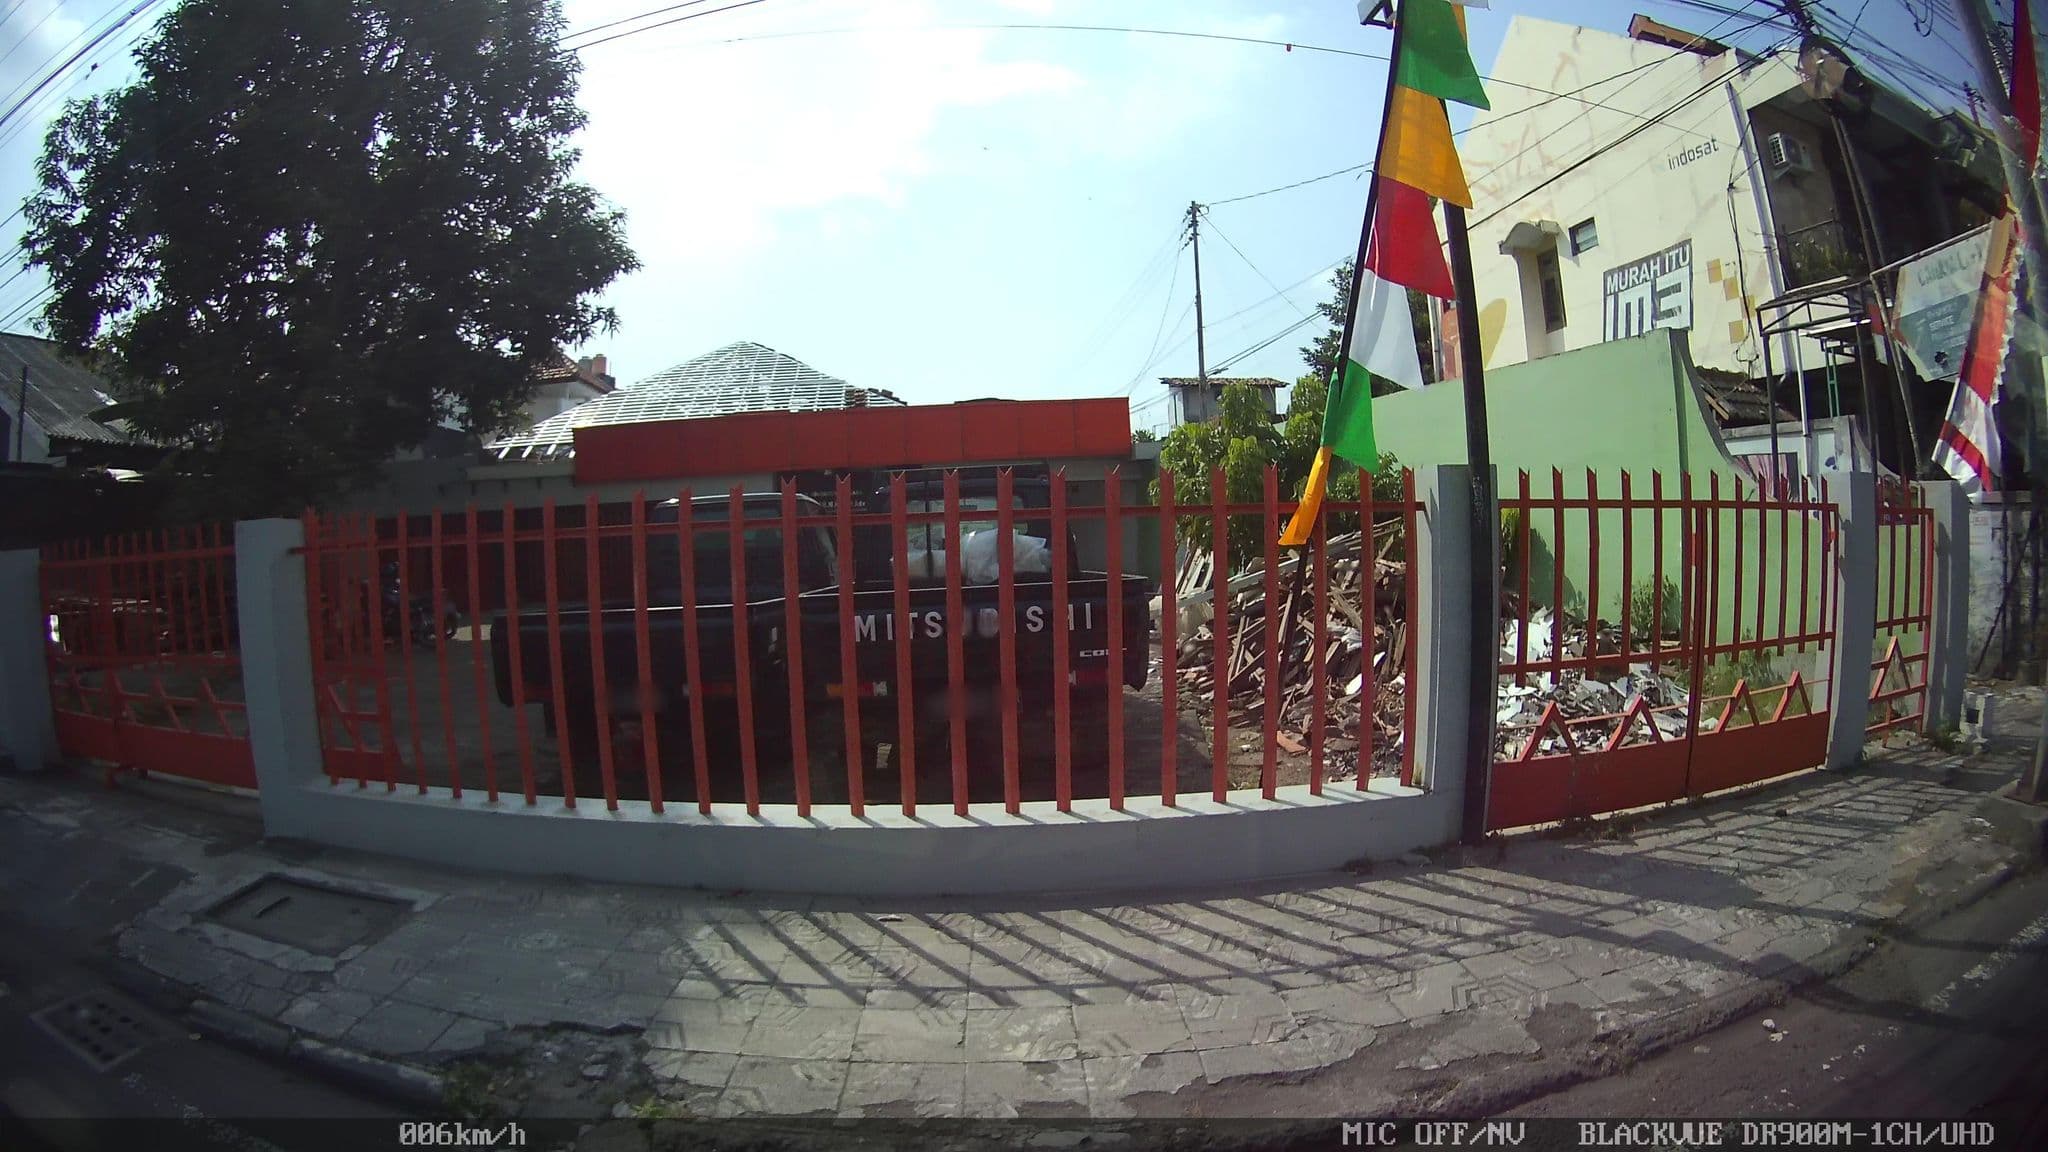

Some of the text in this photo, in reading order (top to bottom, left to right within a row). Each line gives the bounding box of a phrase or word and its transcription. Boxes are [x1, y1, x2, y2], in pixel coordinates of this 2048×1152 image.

[1667, 135, 1720, 171] indosat
[1606, 243, 1691, 296] MURAH ITU
[853, 602, 1093, 643] MITSBSI
